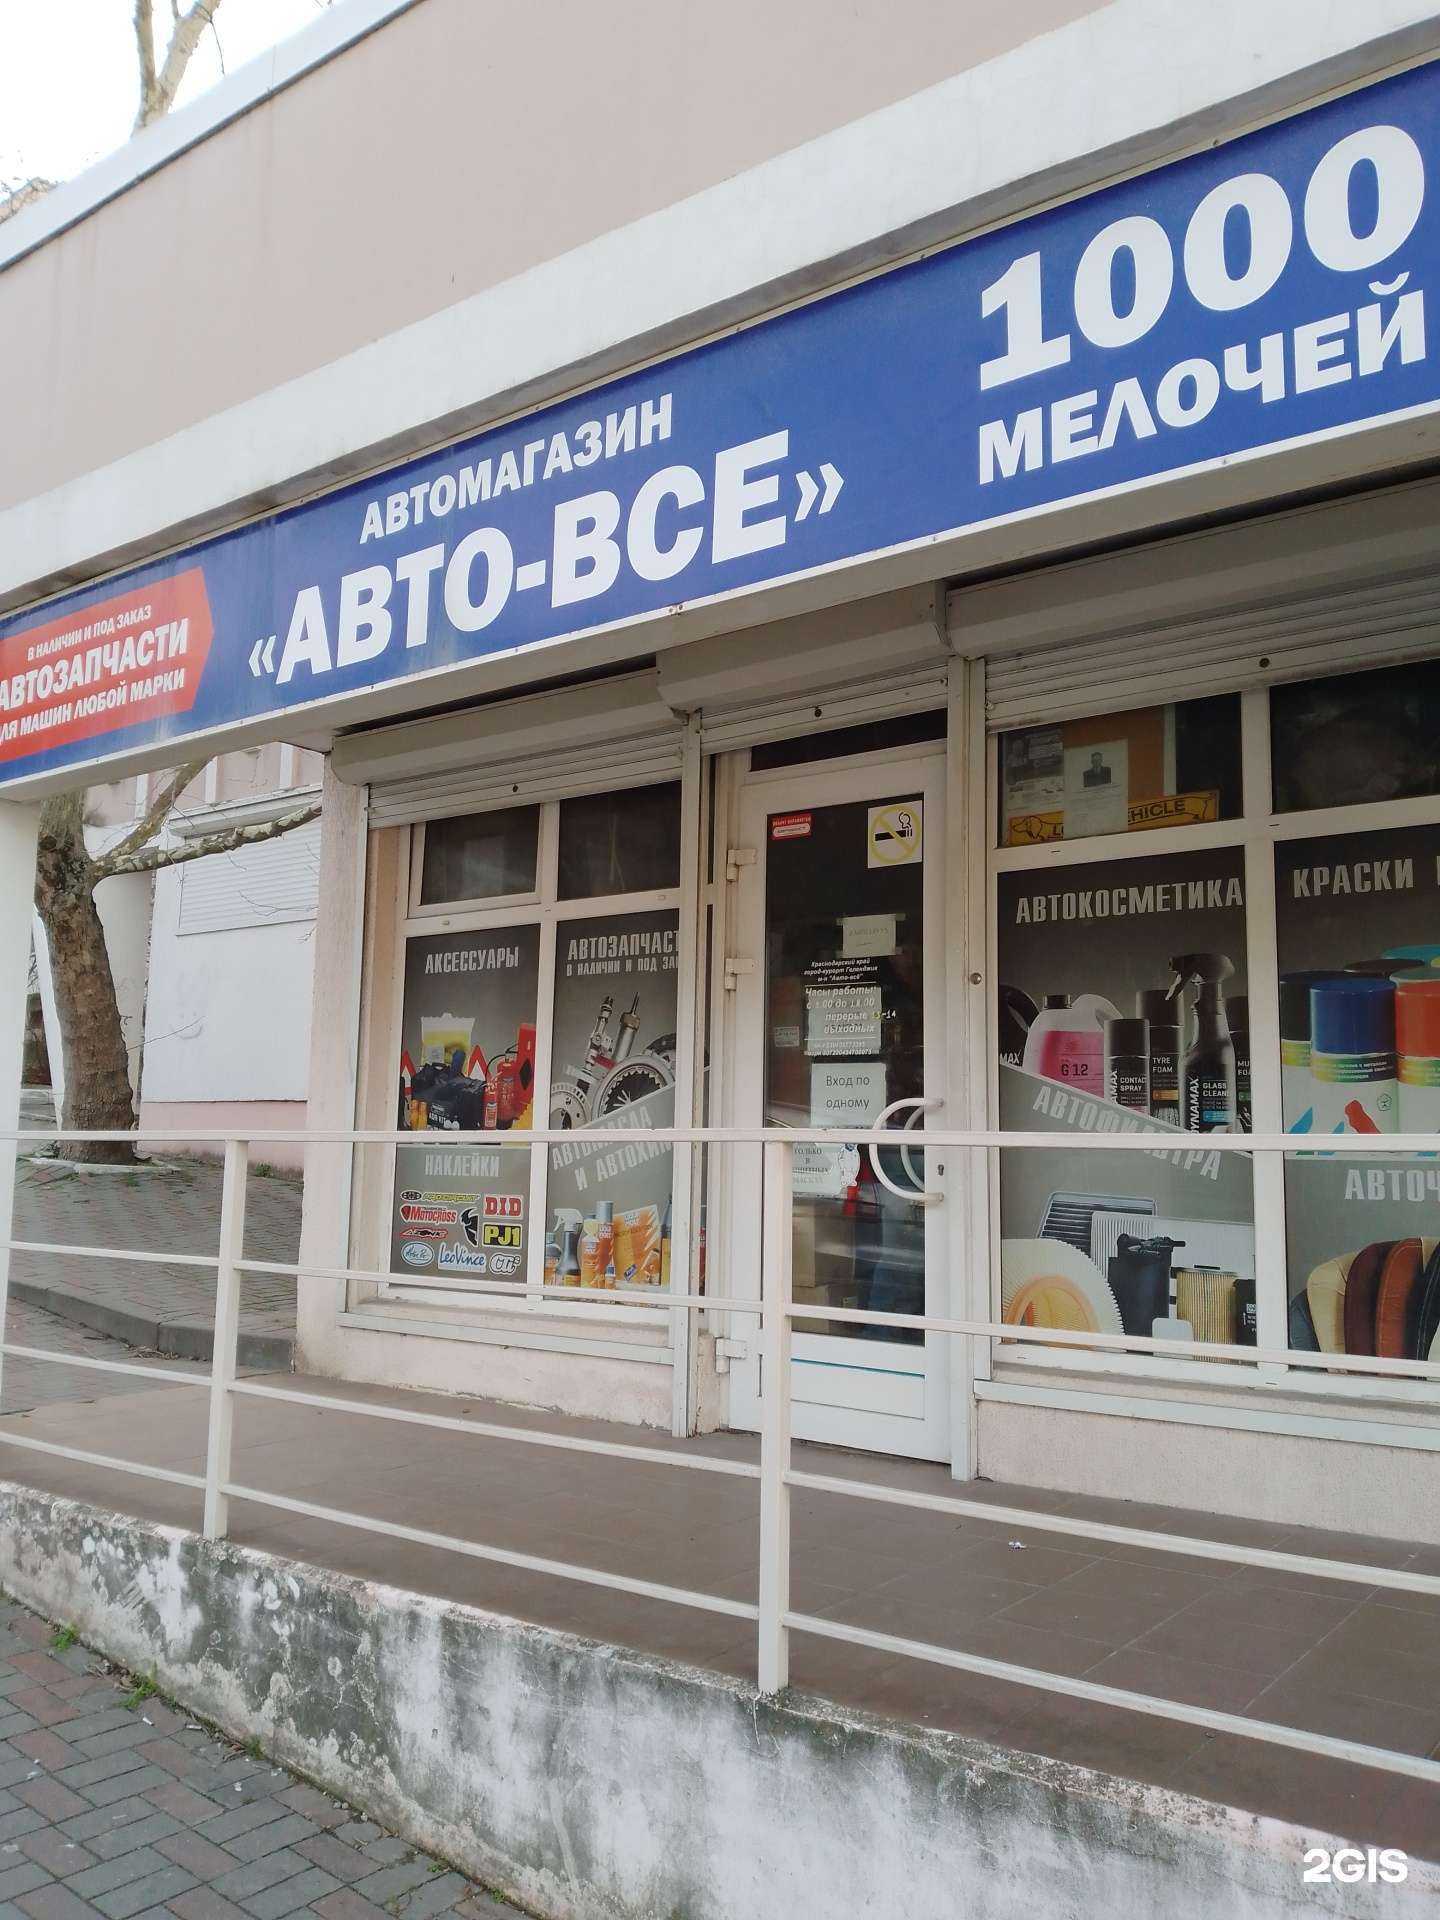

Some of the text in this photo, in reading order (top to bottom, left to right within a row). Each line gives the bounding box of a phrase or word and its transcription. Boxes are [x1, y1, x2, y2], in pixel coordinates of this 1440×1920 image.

[980, 125, 1425, 390] 1000
[979, 271, 1426, 485] МЕЛОЧЕЙ
[359, 393, 673, 545] АВТОМАГАЗИН
[248, 429, 845, 685] «АВТО-ВСЕ»
[27, 605, 152, 661] В НАЛИЧИИ И ПОД ЗАКАЗ
[0, 618, 189, 711] АВТОЗАПЧАСТИ
[0, 668, 186, 745] ЛЯ МАШИН ЛЮБОЙ МАРКИ
[1128, 800, 1186, 823] HICLE
[1293, 858, 1414, 898] КРАСКИ
[1016, 878, 1244, 924] АВТОКОСМЕТИКА
[425, 946, 519, 974] АКСЕССУАРЫ
[566, 963, 573, 976] В
[577, 960, 620, 975] НАЛИЧИИ
[625, 959, 632, 972] И
[638, 957, 658, 972] ПОД
[826, 1075, 870, 1088] Вход по
[826, 1098, 870, 1111] одному
[425, 1152, 500, 1177] НАКЛЕЙКИ
[574, 1167, 589, 1191] И
[484, 1225, 521, 1246] PJ1
[440, 1242, 485, 1266] LeoVince
